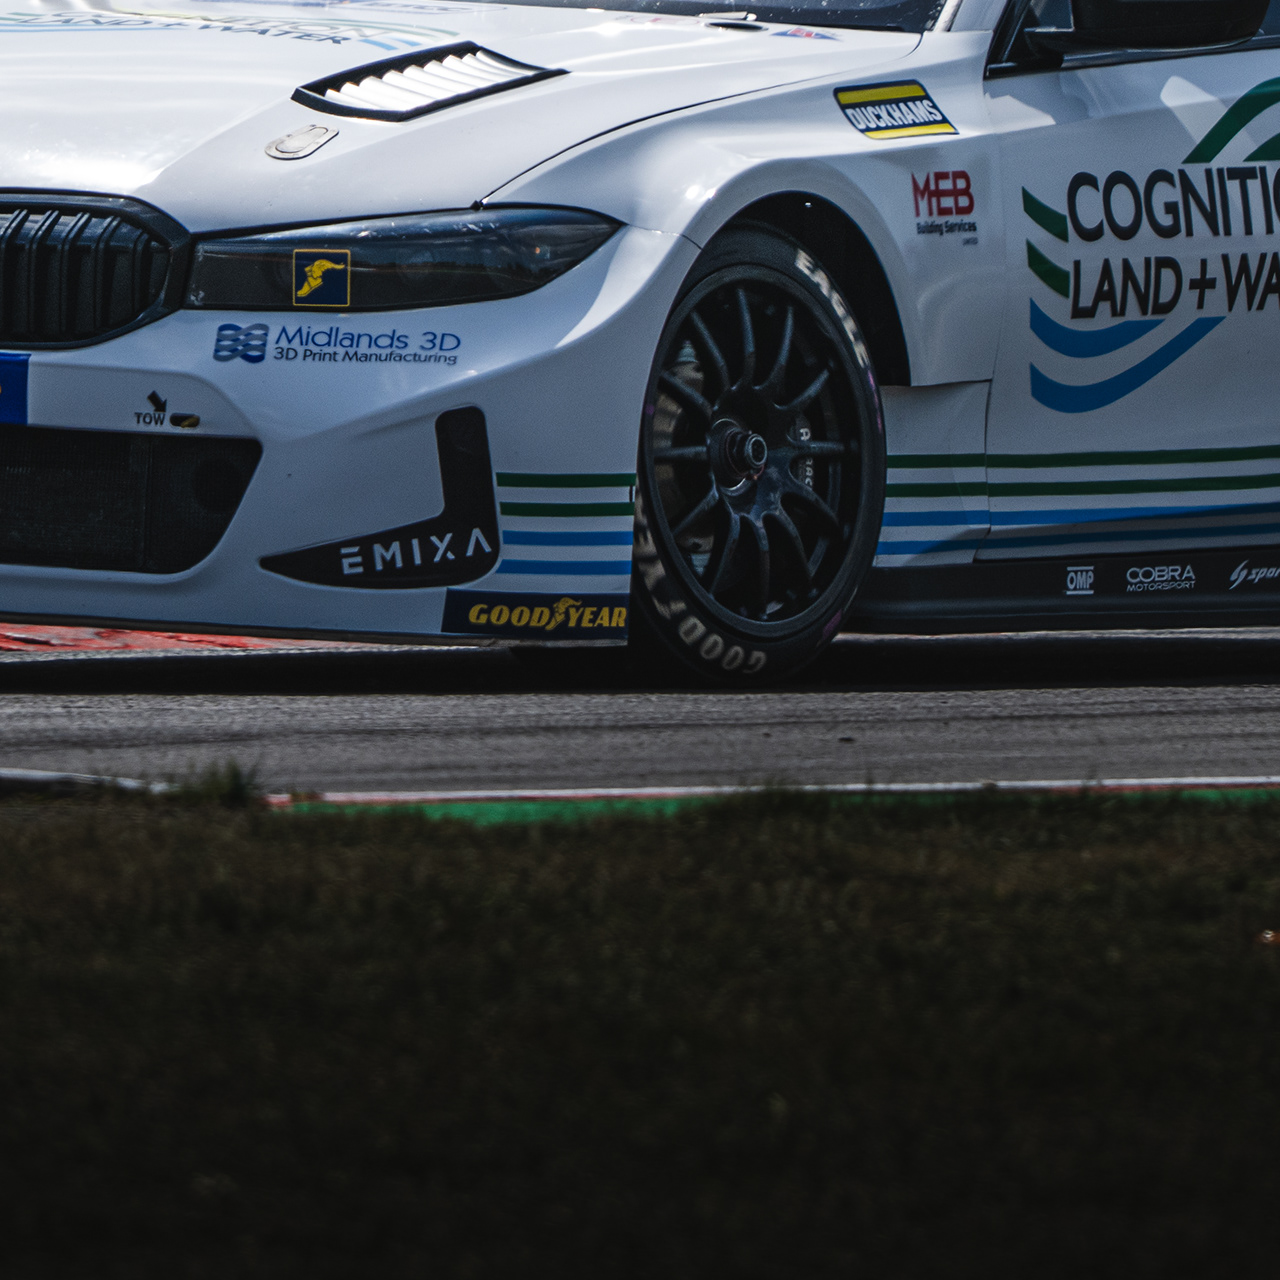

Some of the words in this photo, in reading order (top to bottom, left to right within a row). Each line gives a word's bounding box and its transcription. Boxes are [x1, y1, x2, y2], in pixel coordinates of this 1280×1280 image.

[844, 99, 943, 130] DUCKHAMS
[910, 169, 975, 218] MEB
[275, 325, 409, 350] Midlands
[418, 331, 461, 352] 3D
[273, 346, 298, 361] 3D
[302, 348, 338, 363] Print
[341, 349, 458, 366] Manufacturing
[134, 411, 166, 427] TOW
[339, 526, 493, 576] EMIXA
[1066, 571, 1095, 590] OMP
[1126, 565, 1196, 583] COBRA
[1126, 580, 1196, 592] MOTORSPORT
[468, 598, 628, 631] GOODYEAR
